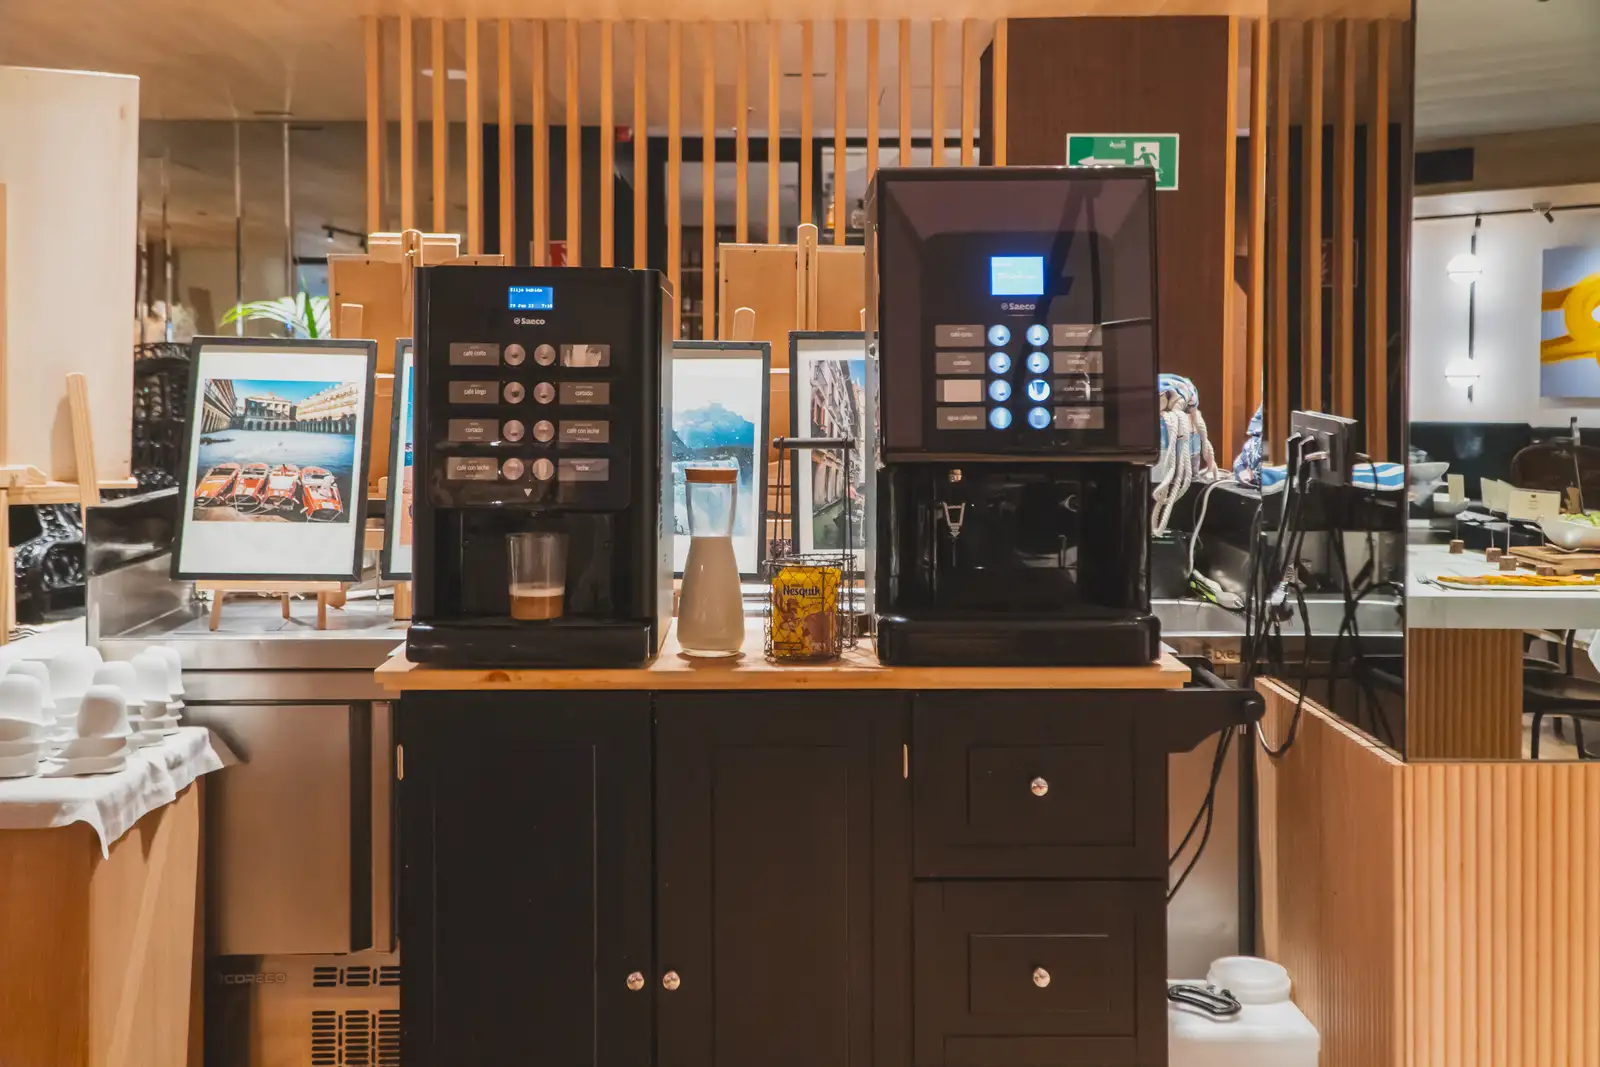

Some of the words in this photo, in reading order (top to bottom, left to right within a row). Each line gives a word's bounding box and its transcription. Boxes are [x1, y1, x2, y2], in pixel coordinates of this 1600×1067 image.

[1009, 302, 1036, 310] Saeco
[521, 317, 546, 325] Saeco
[783, 584, 820, 598] Nesquik
